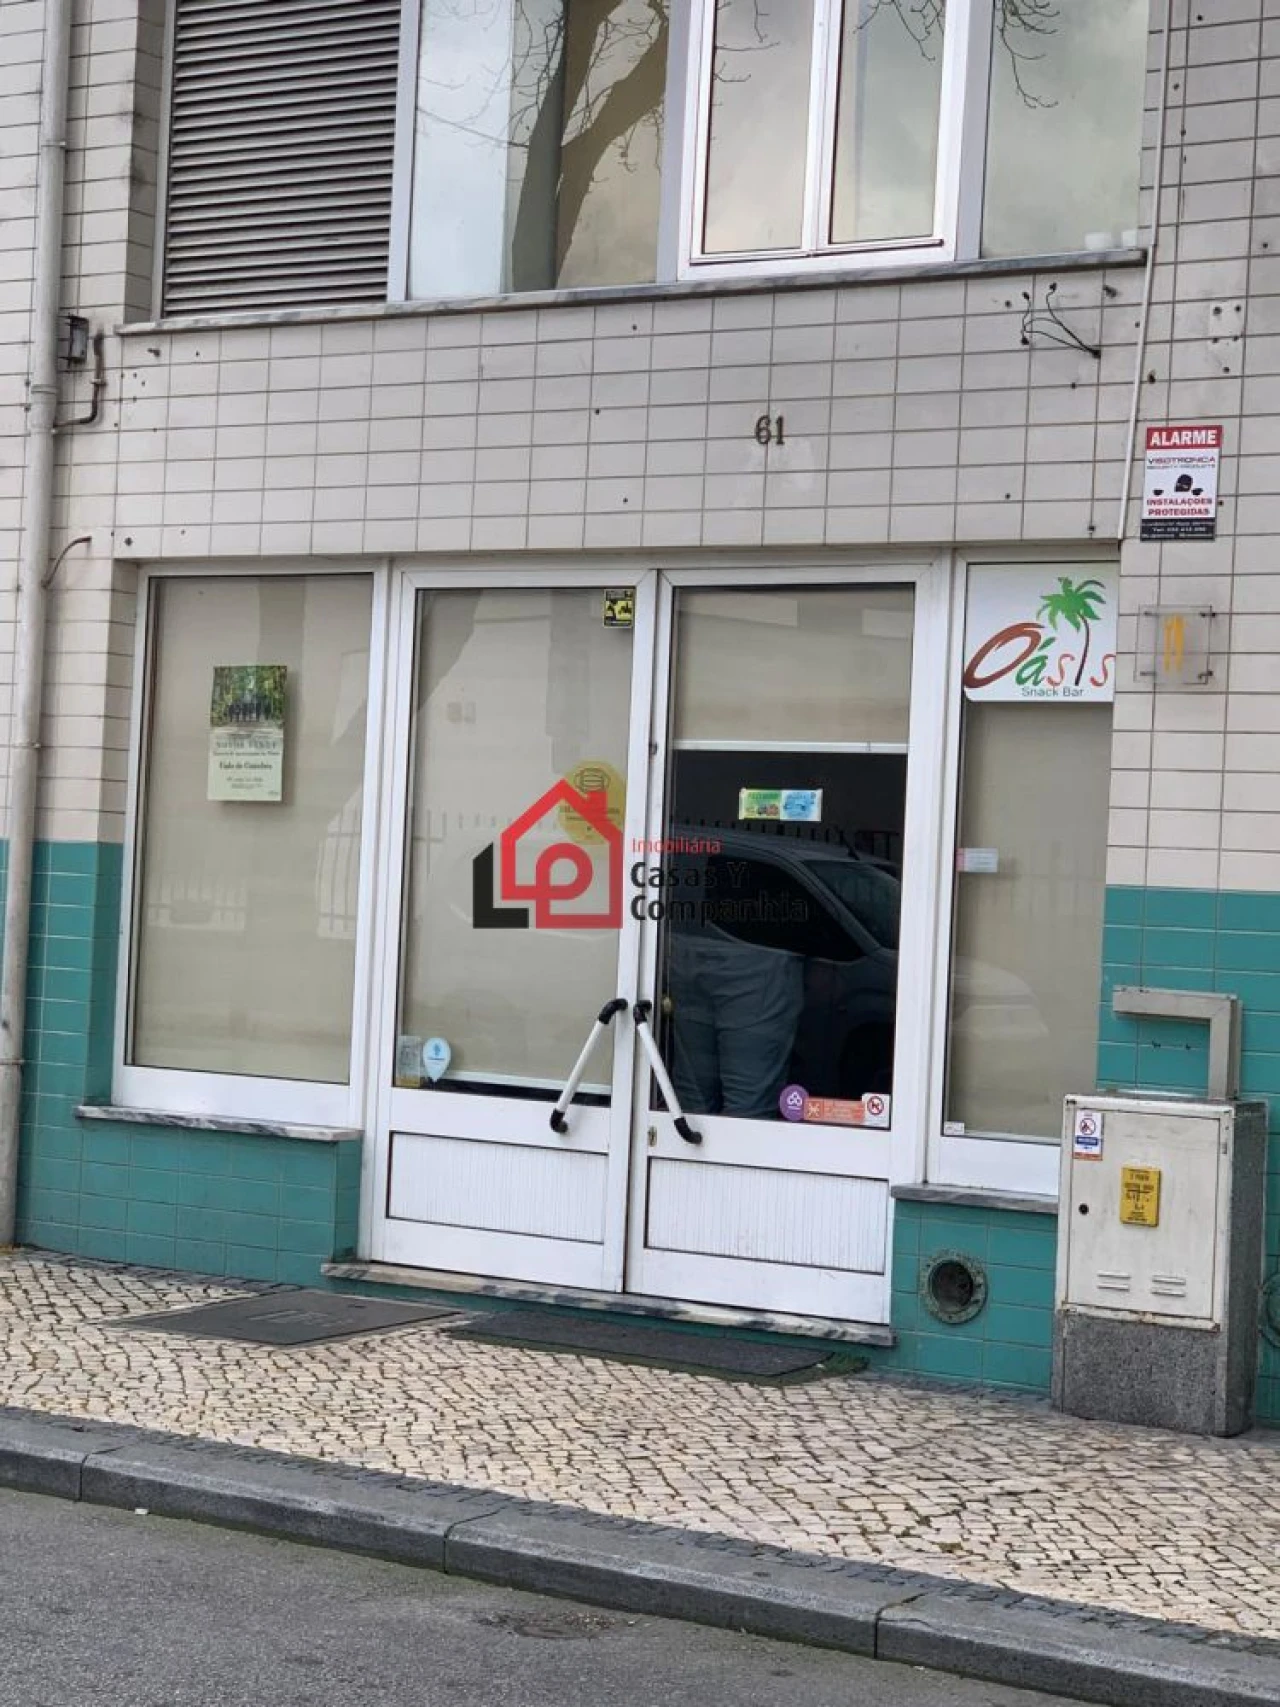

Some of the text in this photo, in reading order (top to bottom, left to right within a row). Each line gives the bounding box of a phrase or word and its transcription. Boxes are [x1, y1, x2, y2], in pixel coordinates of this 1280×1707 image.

[756, 415, 785, 445] 61
[1151, 430, 1217, 446] ALARME
[1148, 508, 1210, 516] PROTEGIDAS
[1021, 686, 1084, 697] Snack Bar
